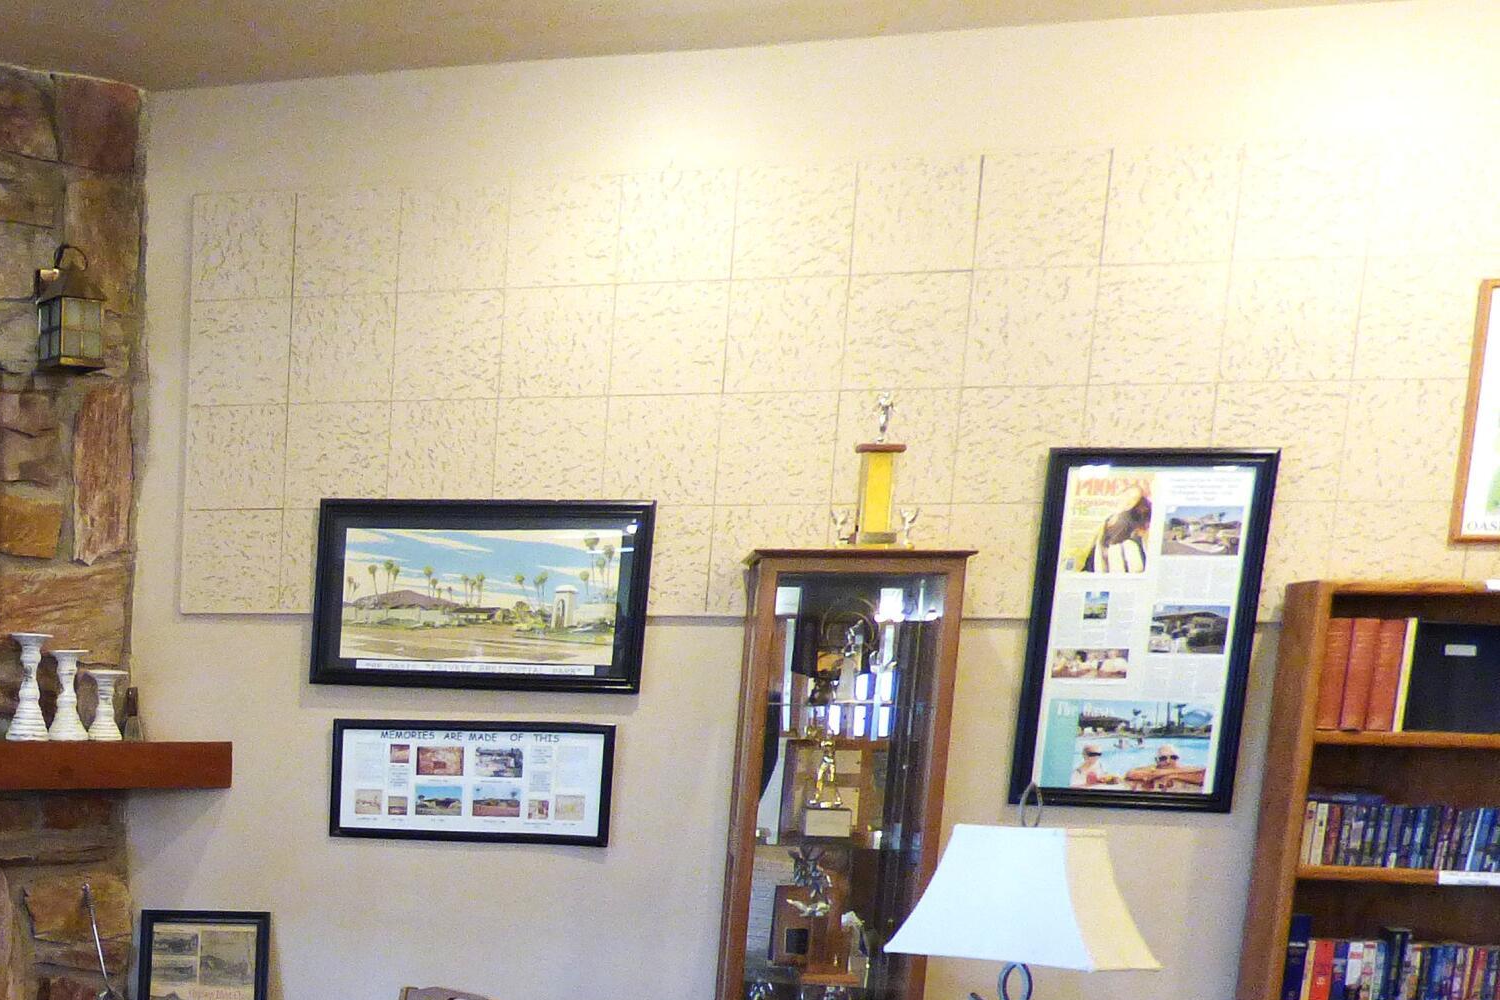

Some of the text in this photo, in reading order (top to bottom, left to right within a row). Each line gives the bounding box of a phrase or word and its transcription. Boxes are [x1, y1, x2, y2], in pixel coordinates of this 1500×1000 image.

[1466, 520, 1500, 531] OAS
[380, 730, 560, 743] MEMORIES ARE MADE OF THIS
